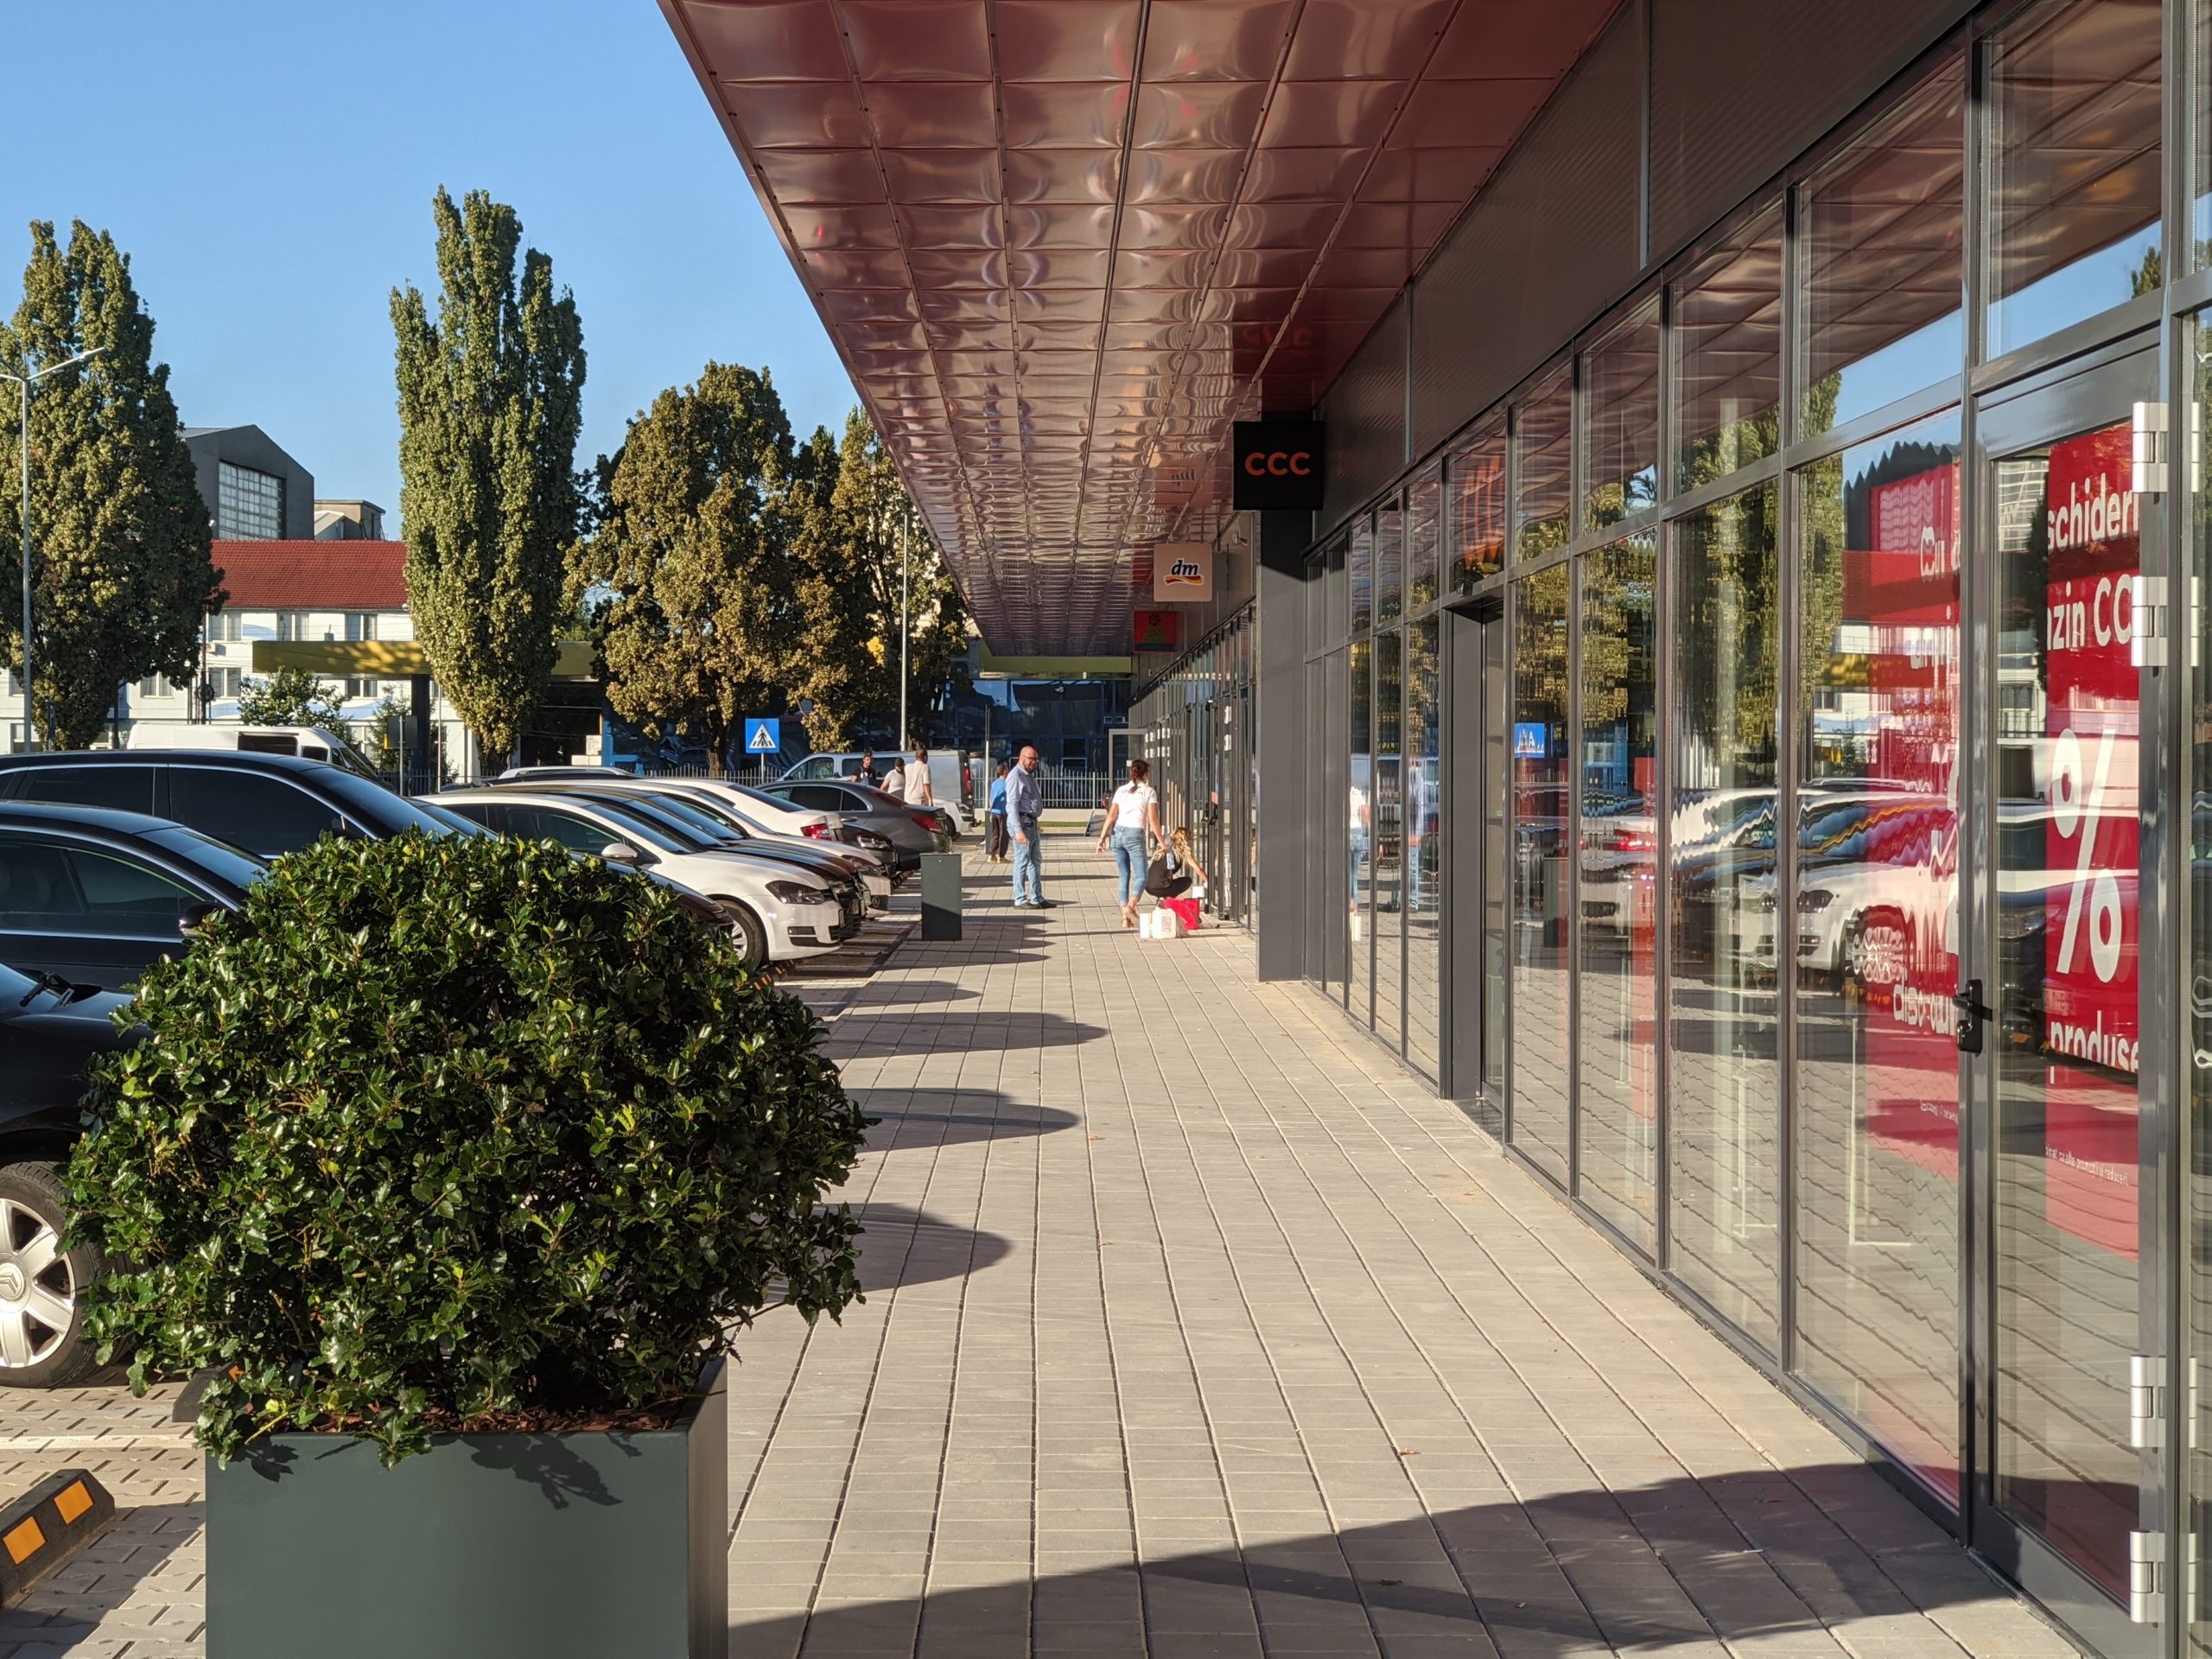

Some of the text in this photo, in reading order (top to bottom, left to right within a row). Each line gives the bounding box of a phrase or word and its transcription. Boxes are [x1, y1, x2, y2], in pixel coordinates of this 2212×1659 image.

[1245, 452, 1311, 476] CCC
[1171, 559, 1198, 575] dm
[2051, 728, 2121, 983] %
